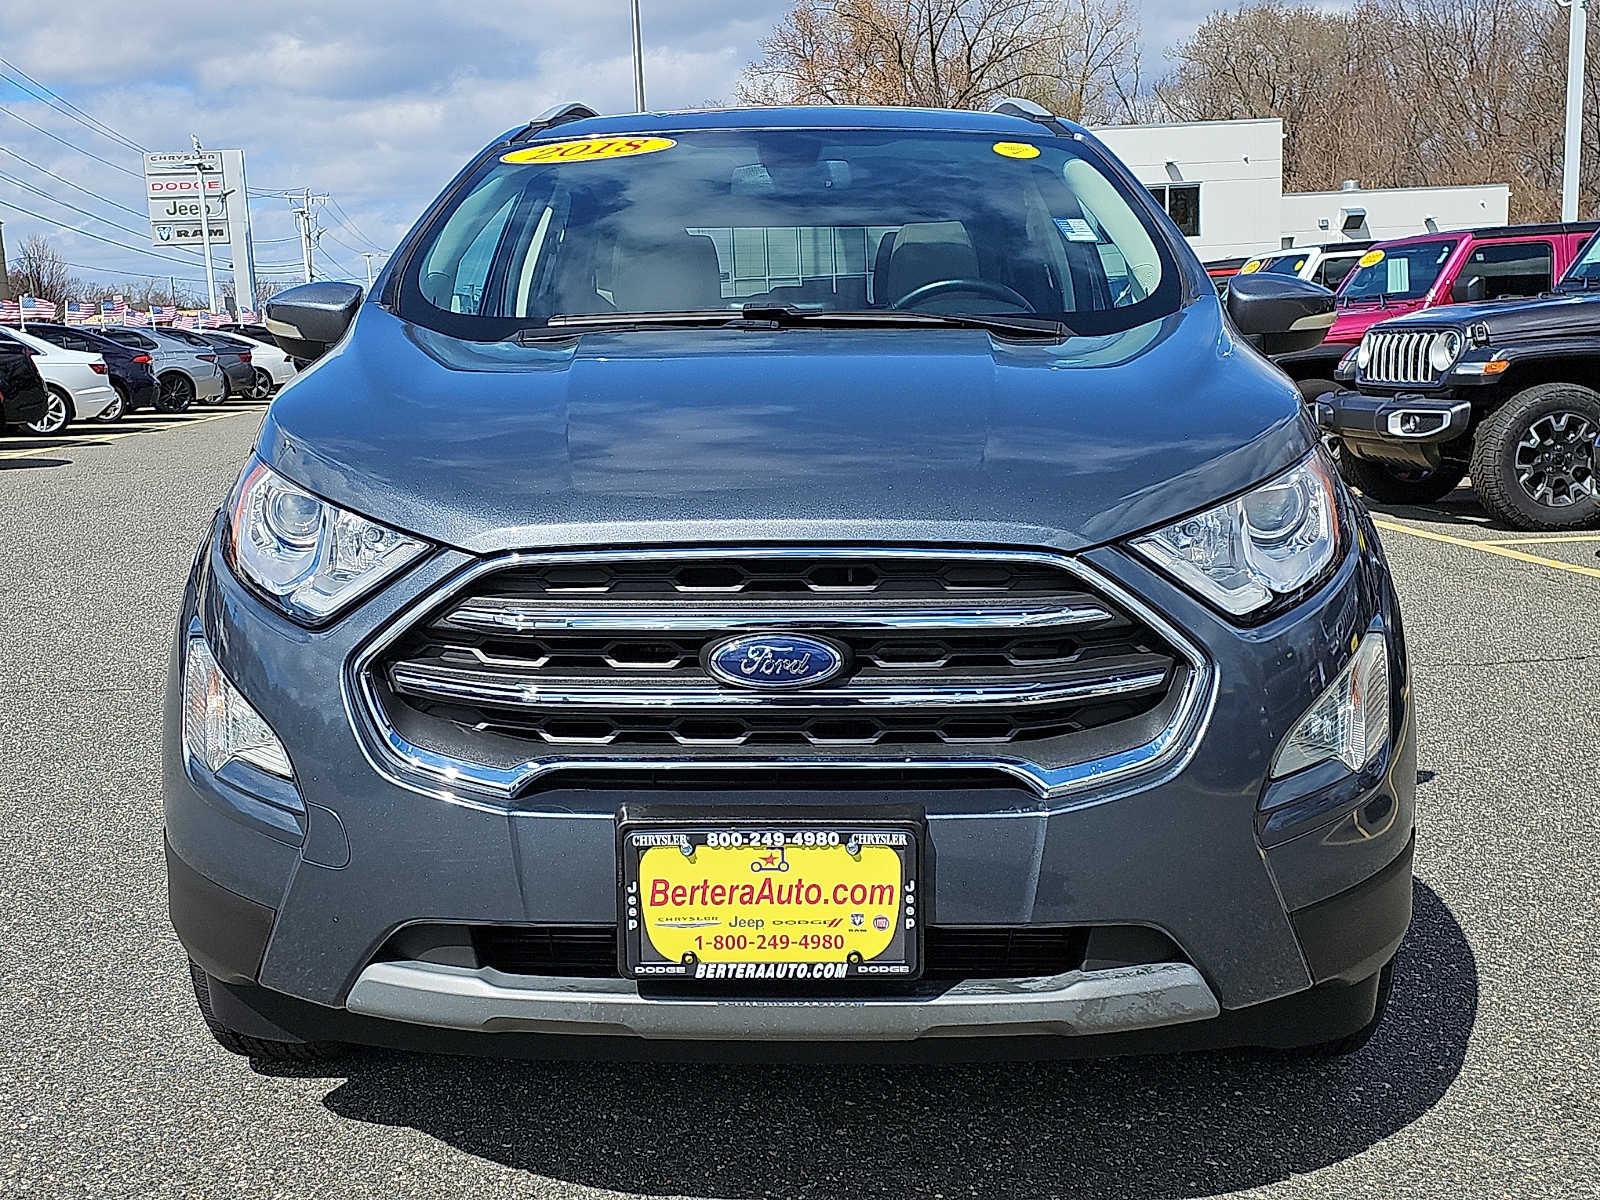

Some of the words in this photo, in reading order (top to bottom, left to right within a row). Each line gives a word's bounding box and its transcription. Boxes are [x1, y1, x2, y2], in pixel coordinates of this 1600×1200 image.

[526, 139, 649, 161] 2018
[740, 645, 811, 675] Ford
[632, 834, 688, 847] CHRYSLER
[706, 832, 840, 847] 800-249-4980
[851, 833, 908, 846] CHRYSLER
[650, 877, 895, 907] BerteraAuto.com
[627, 881, 638, 931] Jeep
[904, 880, 915, 930] Jeep
[728, 915, 765, 930] Jeep
[694, 934, 845, 951] 1-800-249-4980
[634, 965, 686, 974] DODGE
[695, 962, 849, 979] BERTERAAUTO.COM
[857, 965, 910, 974] DODGE
